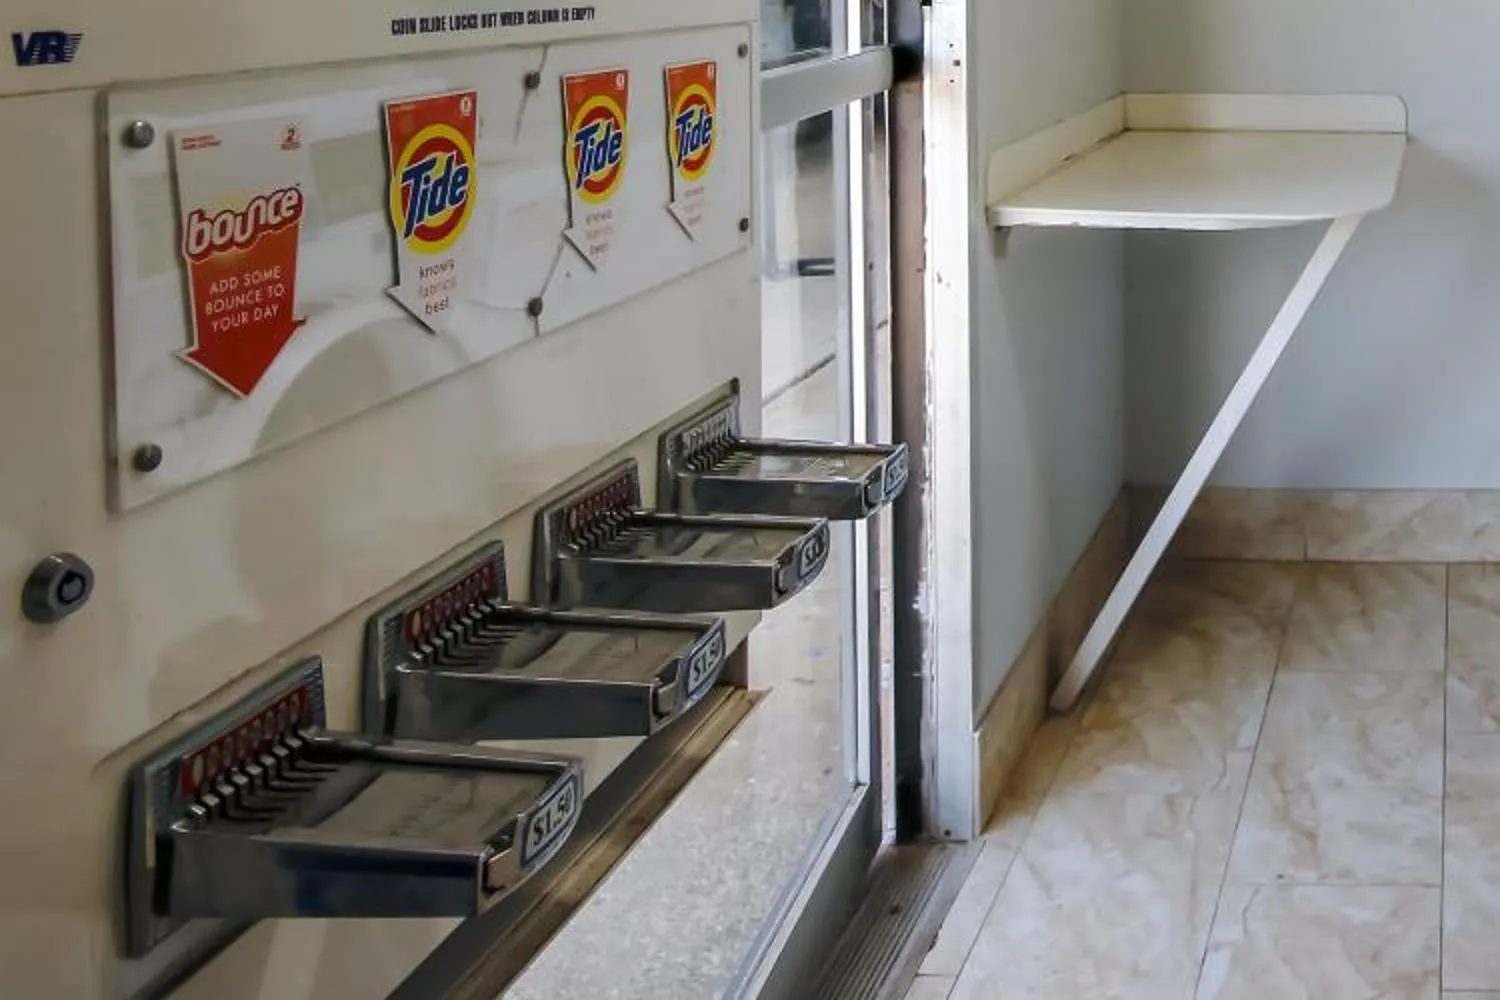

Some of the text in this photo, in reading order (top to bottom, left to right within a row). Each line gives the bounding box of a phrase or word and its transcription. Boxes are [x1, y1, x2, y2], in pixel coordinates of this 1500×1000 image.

[391, 18, 416, 35] COIN
[419, 16, 447, 33] SLIDE
[449, 14, 478, 31] LOCKS
[500, 11, 524, 26] WHEN
[571, 7, 595, 21] EMPTY
[675, 104, 713, 169] Tide
[575, 118, 622, 189] Tide
[401, 151, 469, 239] Tide
[186, 187, 303, 260] bounce
[209, 265, 281, 295] ADD SOME
[419, 258, 455, 279] knows
[205, 283, 285, 316] BOUNCE TO
[425, 298, 449, 317] best
[211, 304, 279, 333] YOUR DAY
